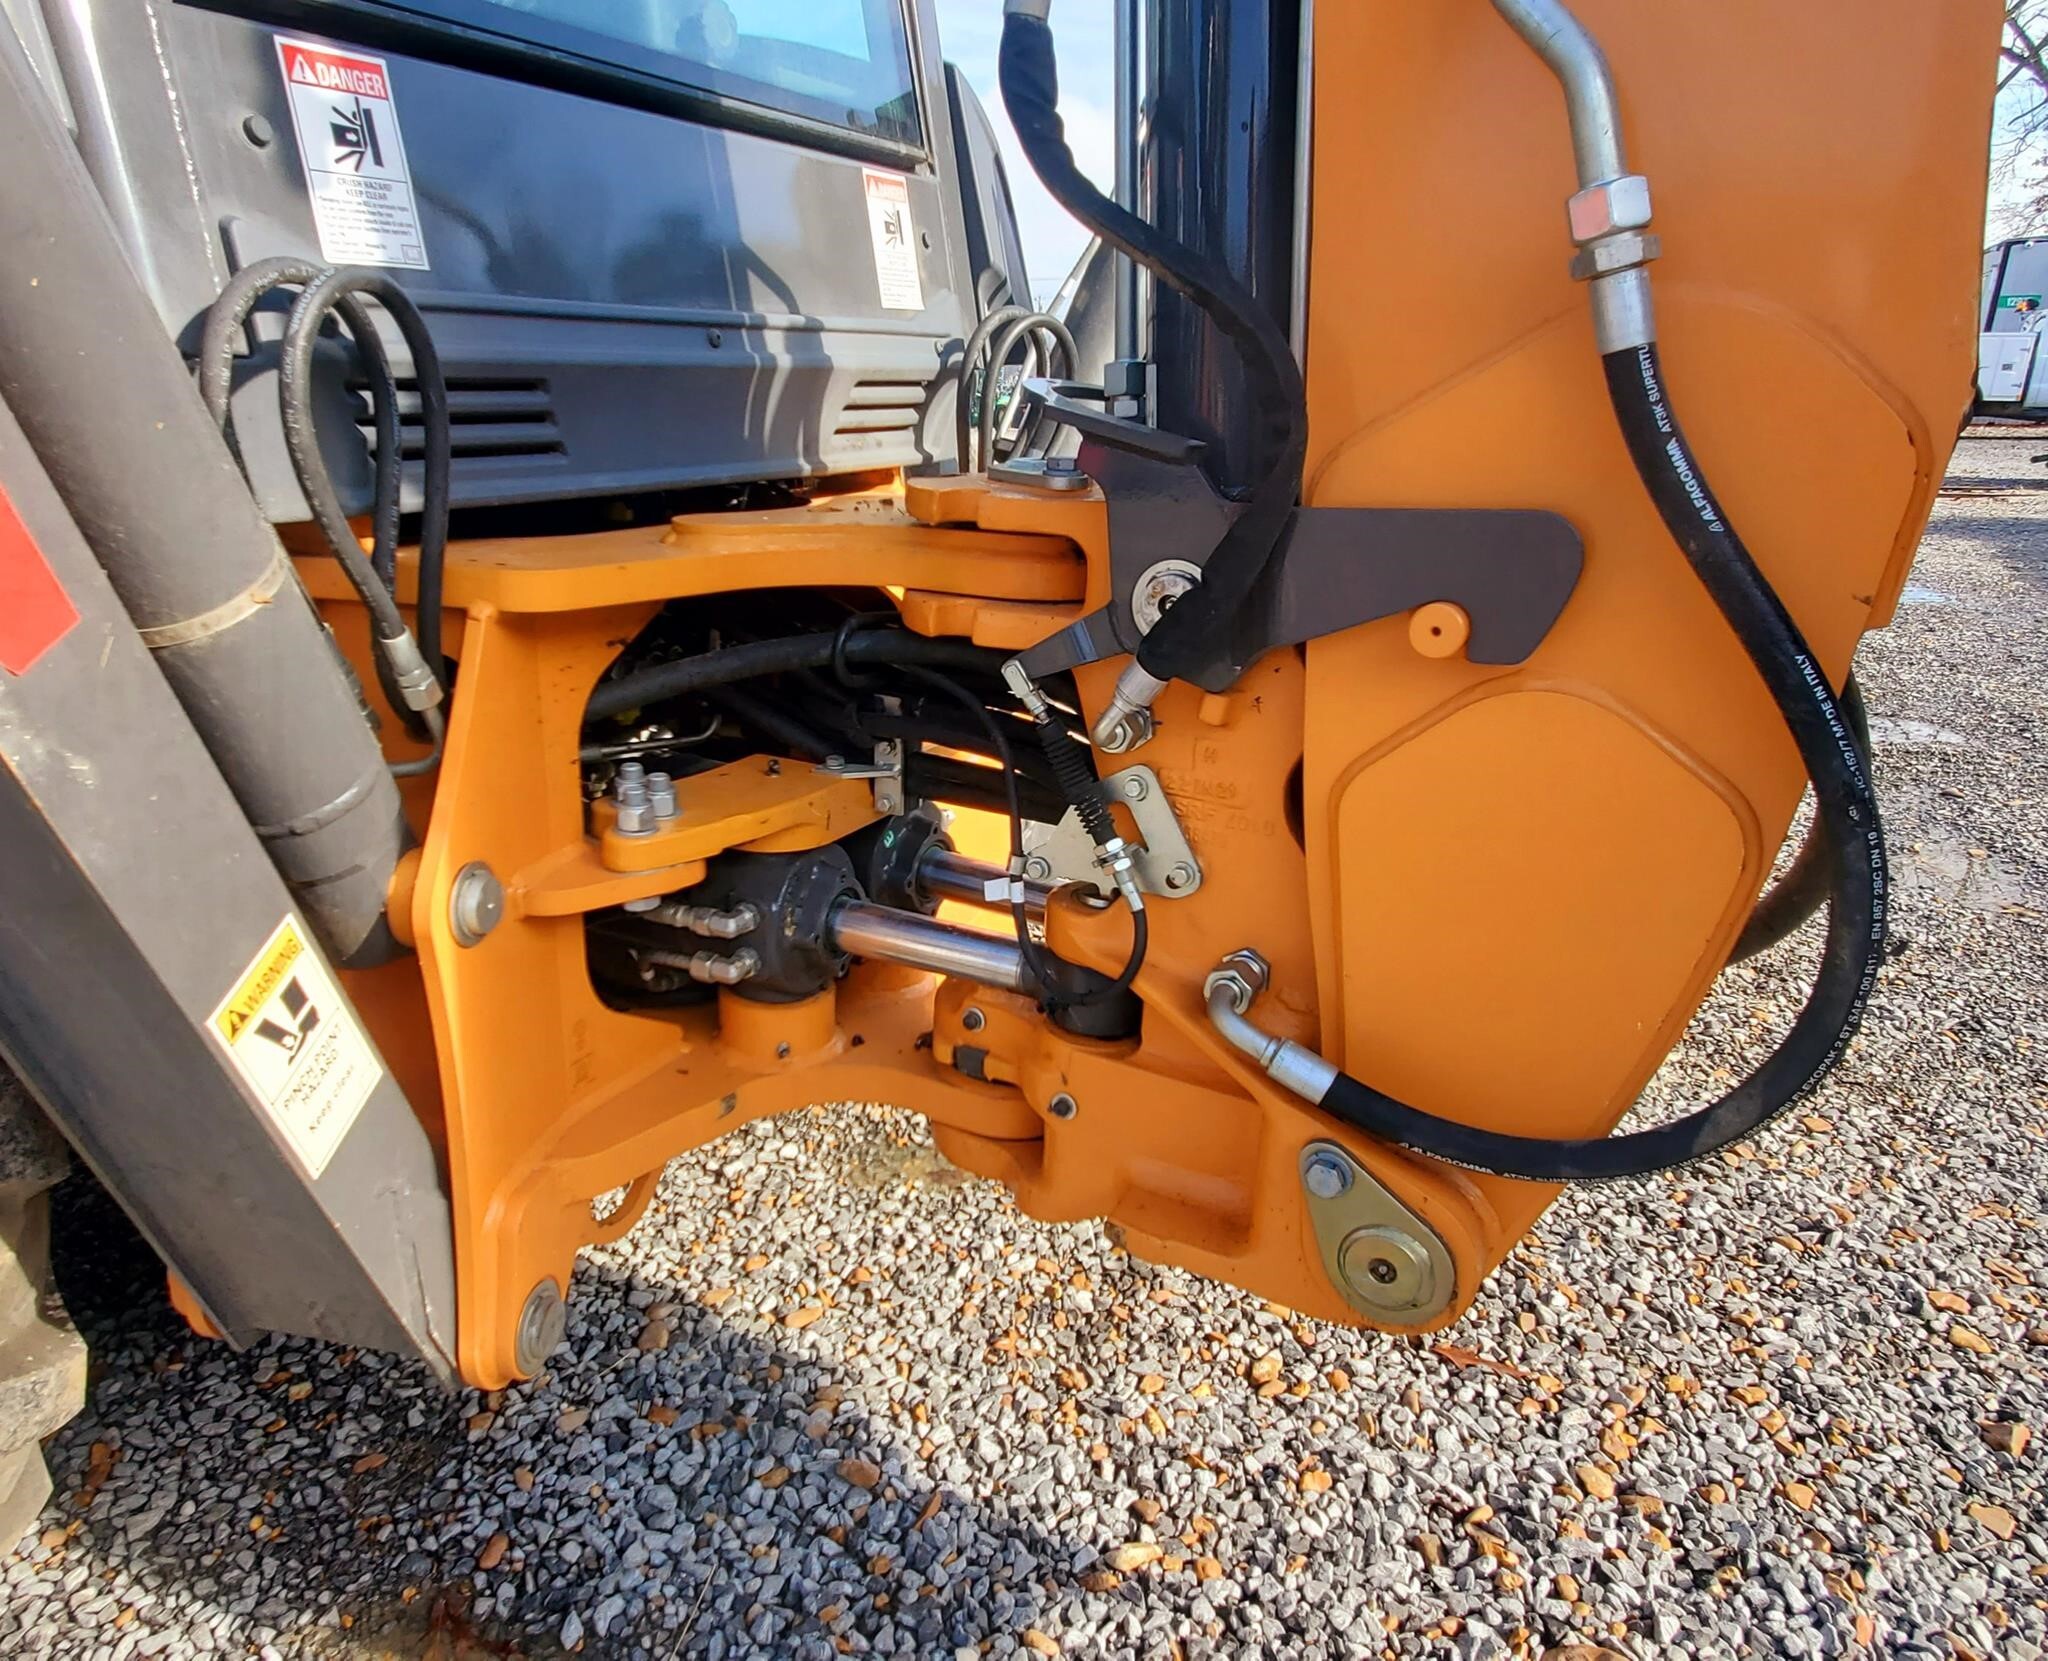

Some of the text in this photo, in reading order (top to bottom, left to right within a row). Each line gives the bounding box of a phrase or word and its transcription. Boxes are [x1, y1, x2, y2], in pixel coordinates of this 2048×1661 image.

[315, 61, 387, 98] DANGER
[1652, 402, 1673, 433] AT3K
[1665, 436, 1718, 522] ALFAGOMMA
[1794, 654, 1819, 686] ITALY
[1813, 684, 1828, 700] IN
[1820, 701, 1846, 738] MADE
[1869, 848, 1882, 867] DN
[1872, 898, 1883, 920] 857
[1870, 921, 1882, 940] EN
[244, 938, 300, 1012] WARNING
[1839, 1024, 1853, 1041] ST
[284, 1023, 342, 1111] PINCH POINT
[302, 1047, 338, 1105] HAZARD
[1791, 1049, 1838, 1104] FLEXOPAK
[1410, 1145, 1496, 1176] ALFAGOMMA
